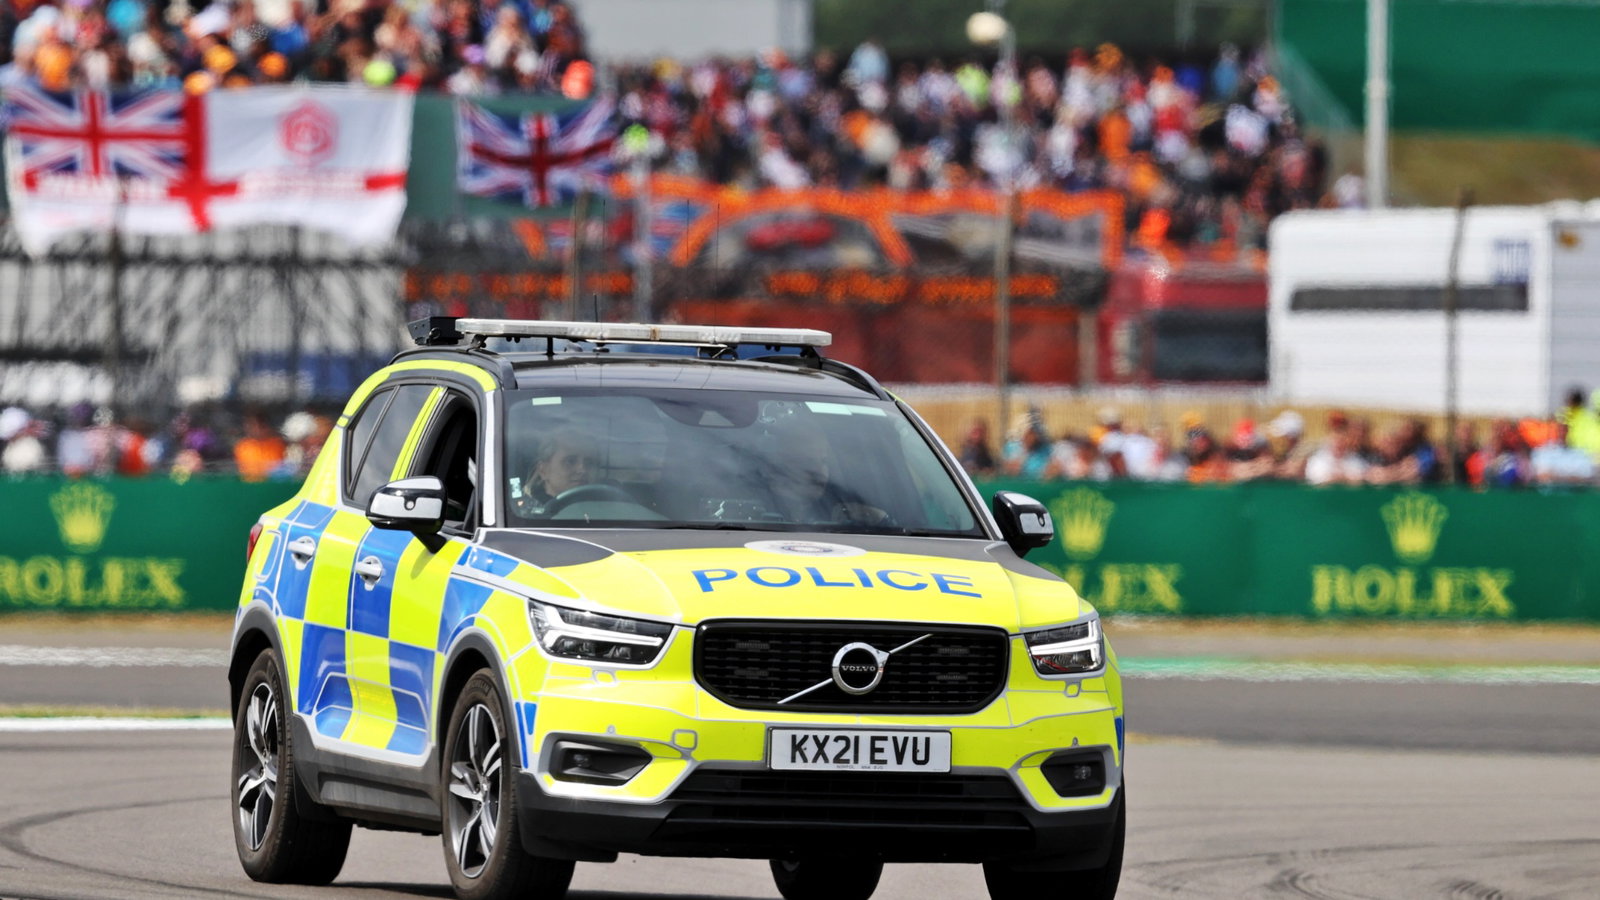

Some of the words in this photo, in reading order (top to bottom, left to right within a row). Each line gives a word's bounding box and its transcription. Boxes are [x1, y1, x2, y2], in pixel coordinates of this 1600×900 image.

[691, 566, 983, 599] POLICE
[1041, 563, 1183, 613] LEX
[1311, 565, 1514, 616] ROLEX
[790, 734, 860, 764] KX21
[869, 736, 931, 765] EVU
